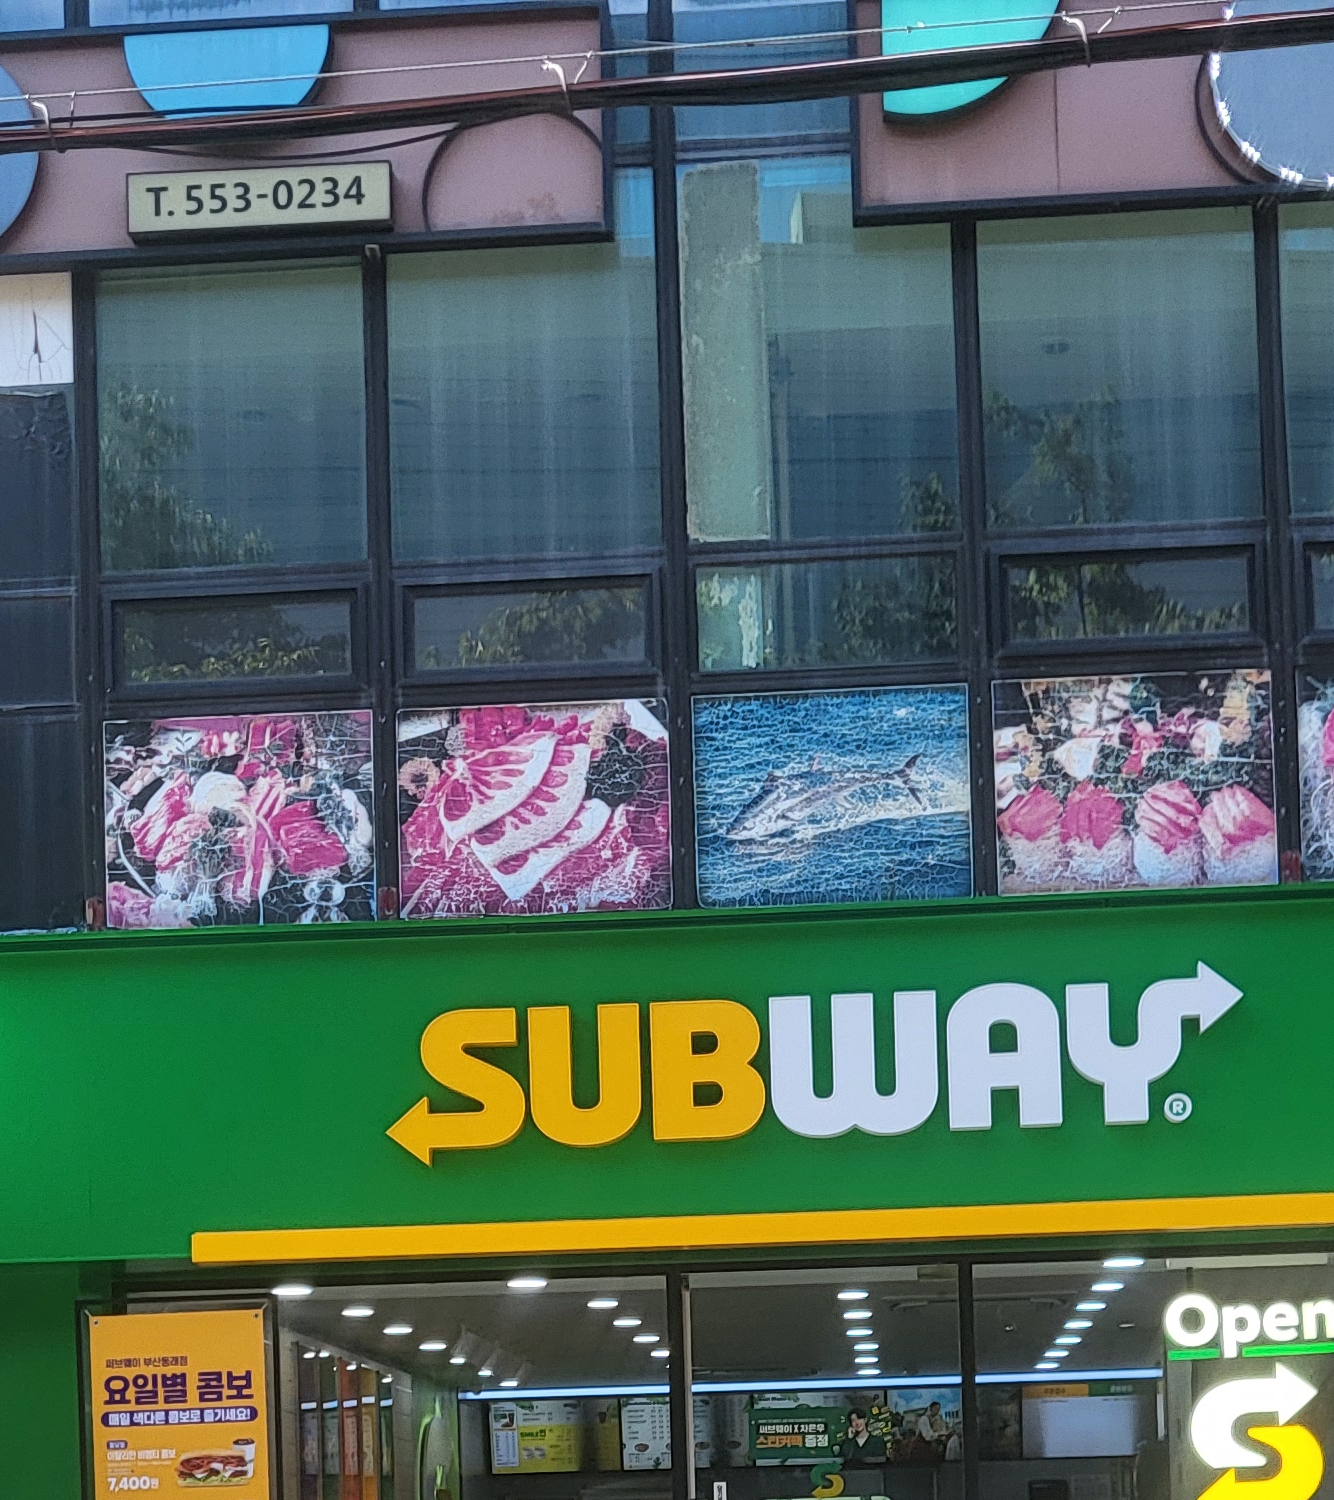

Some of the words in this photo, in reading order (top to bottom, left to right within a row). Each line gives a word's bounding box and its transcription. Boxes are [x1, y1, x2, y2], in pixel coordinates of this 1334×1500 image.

[385, 960, 1244, 1166] SUBWAY
[143, 1355, 188, 1368] 부산동래점
[103, 1372, 188, 1405] 요일별
[197, 1370, 254, 1403] 콤보
[108, 1412, 131, 1426] 매일
[133, 1411, 166, 1425] 색다른
